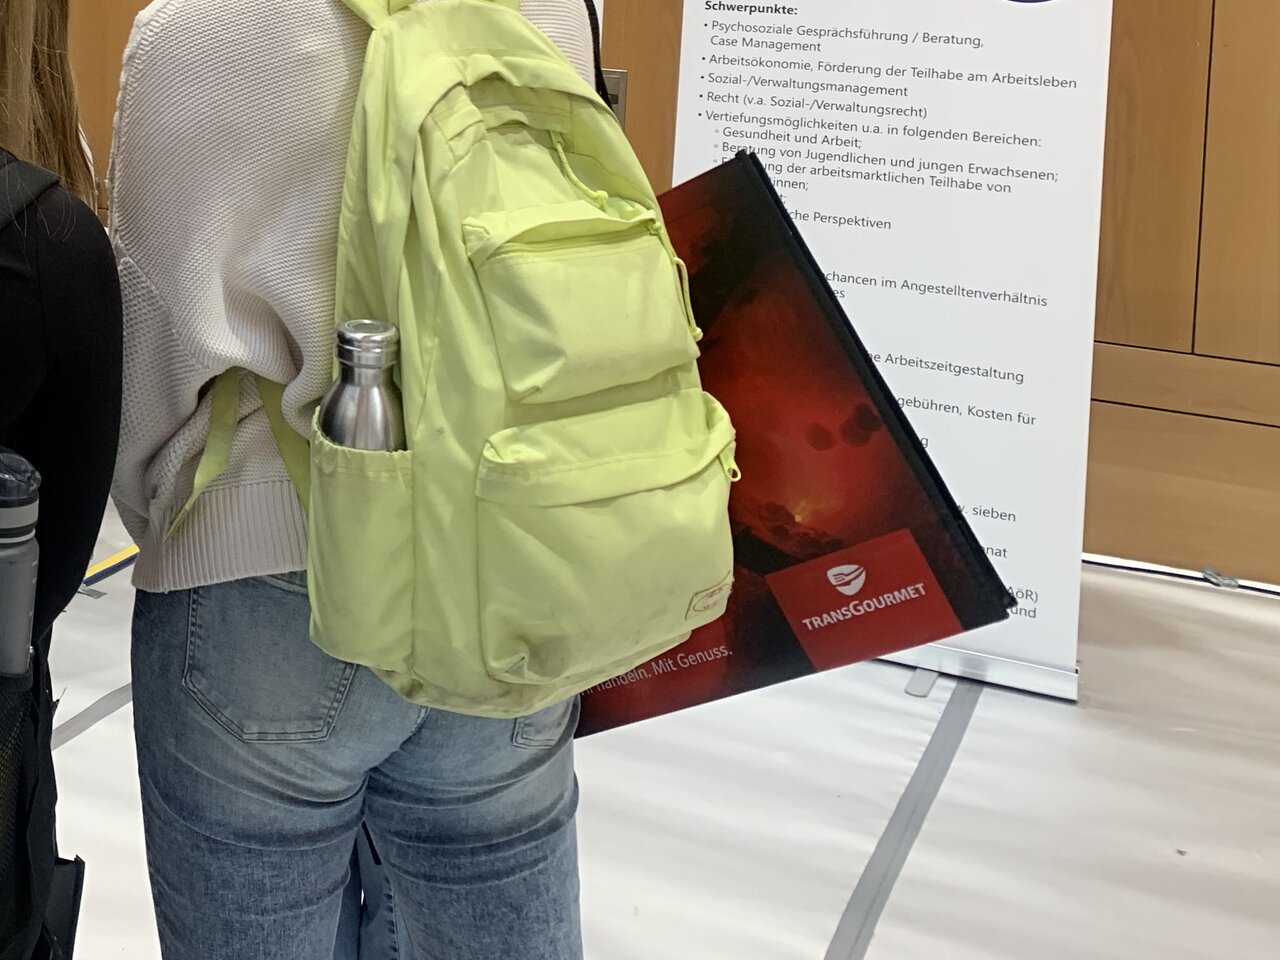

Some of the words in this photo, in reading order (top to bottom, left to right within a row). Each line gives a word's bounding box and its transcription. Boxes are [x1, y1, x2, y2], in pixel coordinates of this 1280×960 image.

[704, 0, 798, 16] Schwerpunkte:
[710, 35, 738, 46] Case
[742, 37, 821, 52] Management
[711, 20, 793, 35] Psychosoziale
[796, 25, 909, 45] Gesprächsführung
[922, 32, 984, 49] Beratung,
[708, 73, 908, 97] Sozial-/Verwaltungsmanagement
[709, 54, 813, 72] Arbeitsökonomie,
[818, 60, 881, 78] Förderung
[886, 65, 906, 76] der
[911, 66, 963, 80] Teilhabe
[967, 72, 987, 82] am
[992, 72, 1077, 88] Arbeitsleben
[707, 91, 739, 103] Recht
[743, 94, 767, 106] (v.a.
[770, 96, 927, 120] Sozial-/Verwaltungsrecht)
[706, 110, 858, 131] Vertiefungsmöglichkeiten
[862, 124, 883, 134] u.a.
[887, 124, 899, 135] in
[903, 124, 968, 140] folgenden
[972, 131, 1042, 147] Bereichen:
[722, 127, 791, 141] Gesundheit
[794, 133, 817, 145] und
[821, 135, 862, 149] Arbeit;
[780, 149, 802, 158] von
[805, 150, 886, 166] Jugendlichen
[890, 157, 915, 169] und
[917, 159, 964, 174] jungen
[969, 163, 1059, 182] Erwachsenen;
[787, 163, 807, 175] der
[810, 164, 925, 186] arbeitsmarktlichen
[929, 175, 983, 191] Teilhabe
[987, 184, 1012, 193] von
[773, 177, 809, 192] innen;
[813, 211, 892, 229] Perspektiven
[826, 271, 877, 286] chancen
[882, 276, 897, 289] im
[901, 279, 1048, 307] Angestelltenverhältnis
[885, 353, 1024, 385] Arbeitszeitgestaltung
[897, 396, 963, 416] gebühren,
[967, 405, 1013, 422] Kosten
[1017, 412, 1036, 425] für
[972, 505, 1017, 522] sieben
[985, 545, 1008, 559] nat
[1007, 586, 1039, 603] AöR)
[651, 659, 677, 676] Mit
[677, 644, 734, 668] Genuss.
